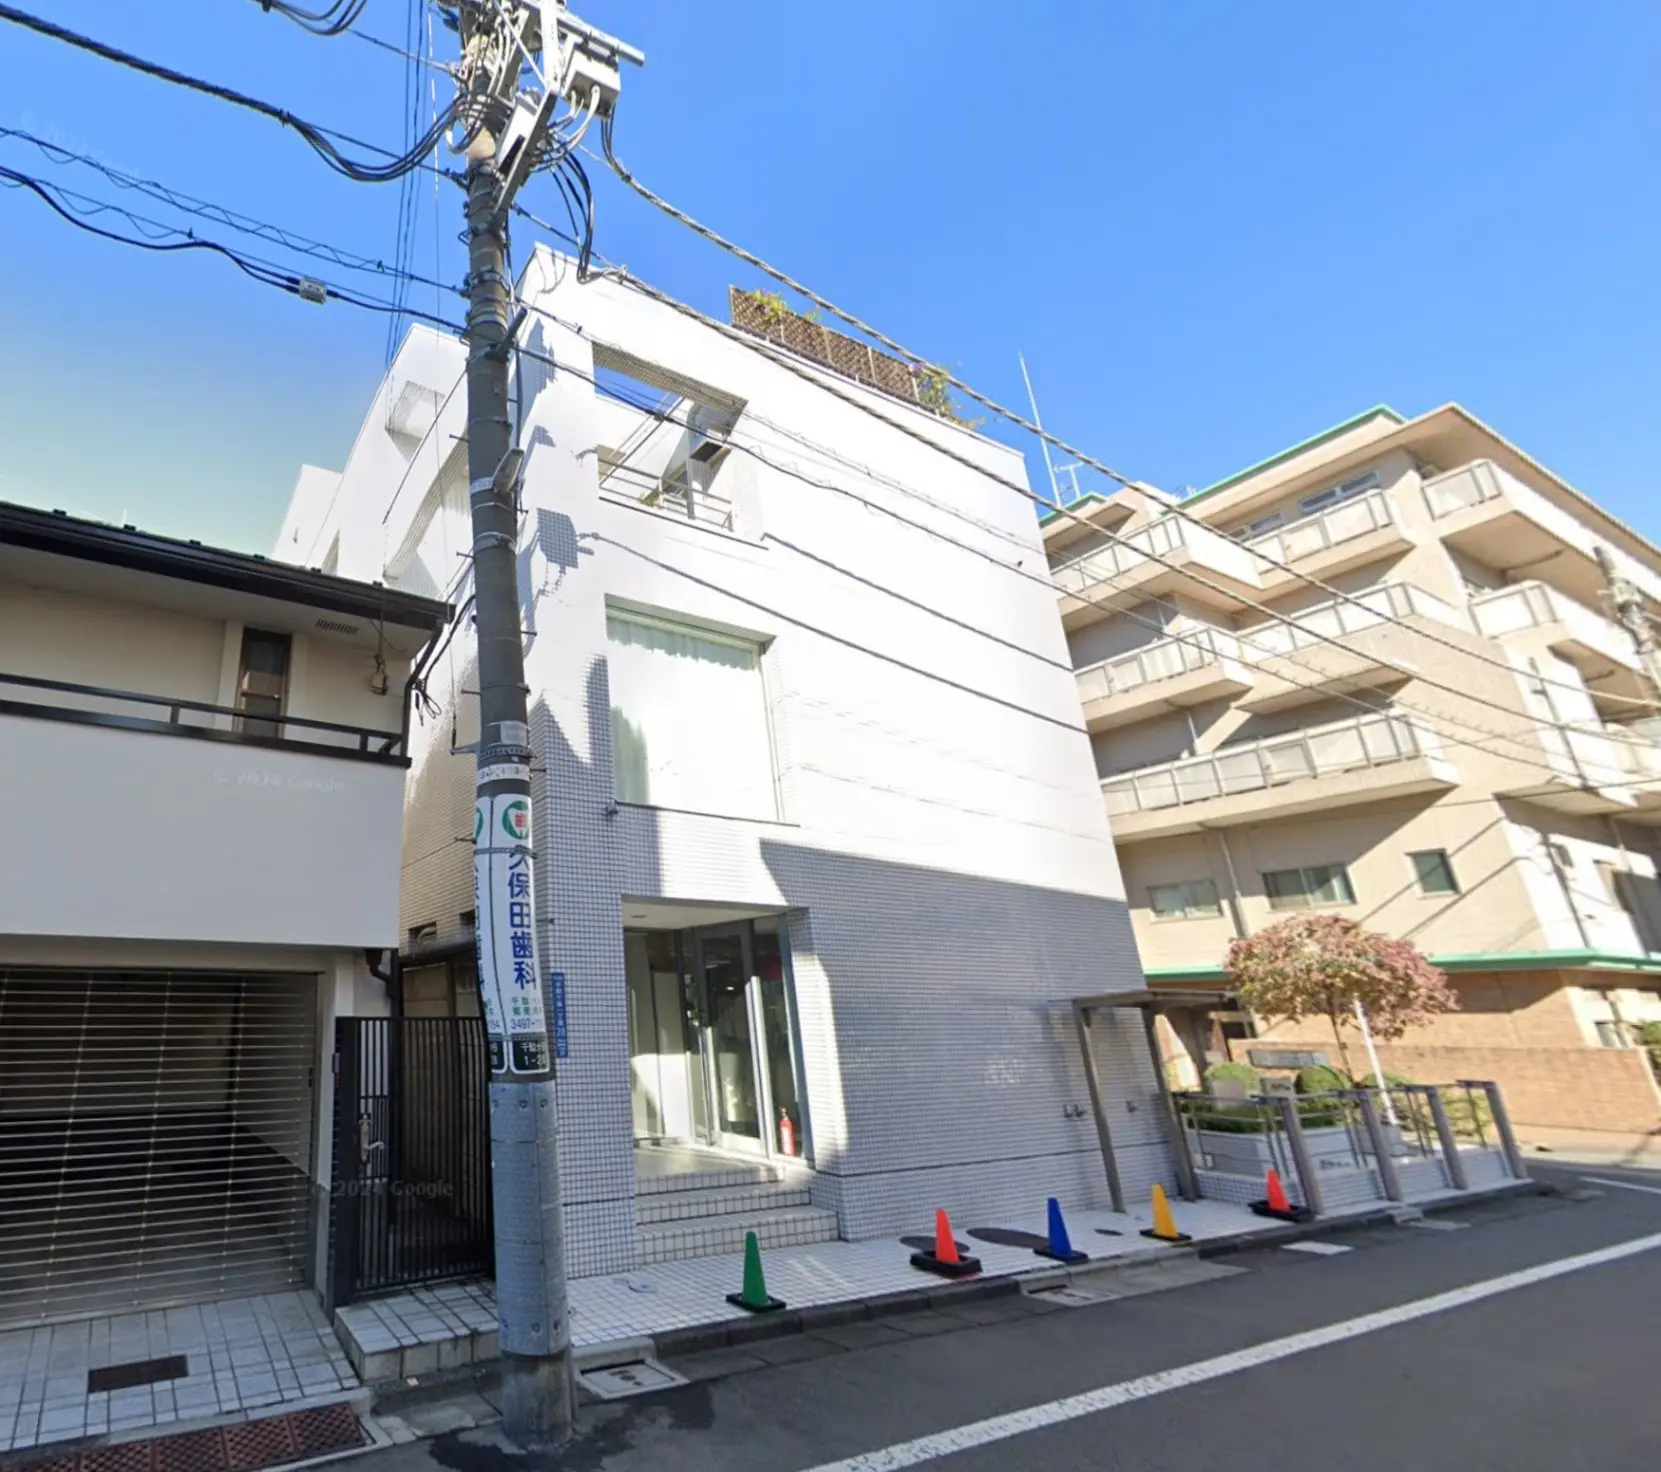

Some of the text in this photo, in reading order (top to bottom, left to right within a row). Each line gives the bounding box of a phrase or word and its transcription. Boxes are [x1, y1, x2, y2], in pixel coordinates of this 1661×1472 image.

[507, 852, 537, 990] 久保田歯科
